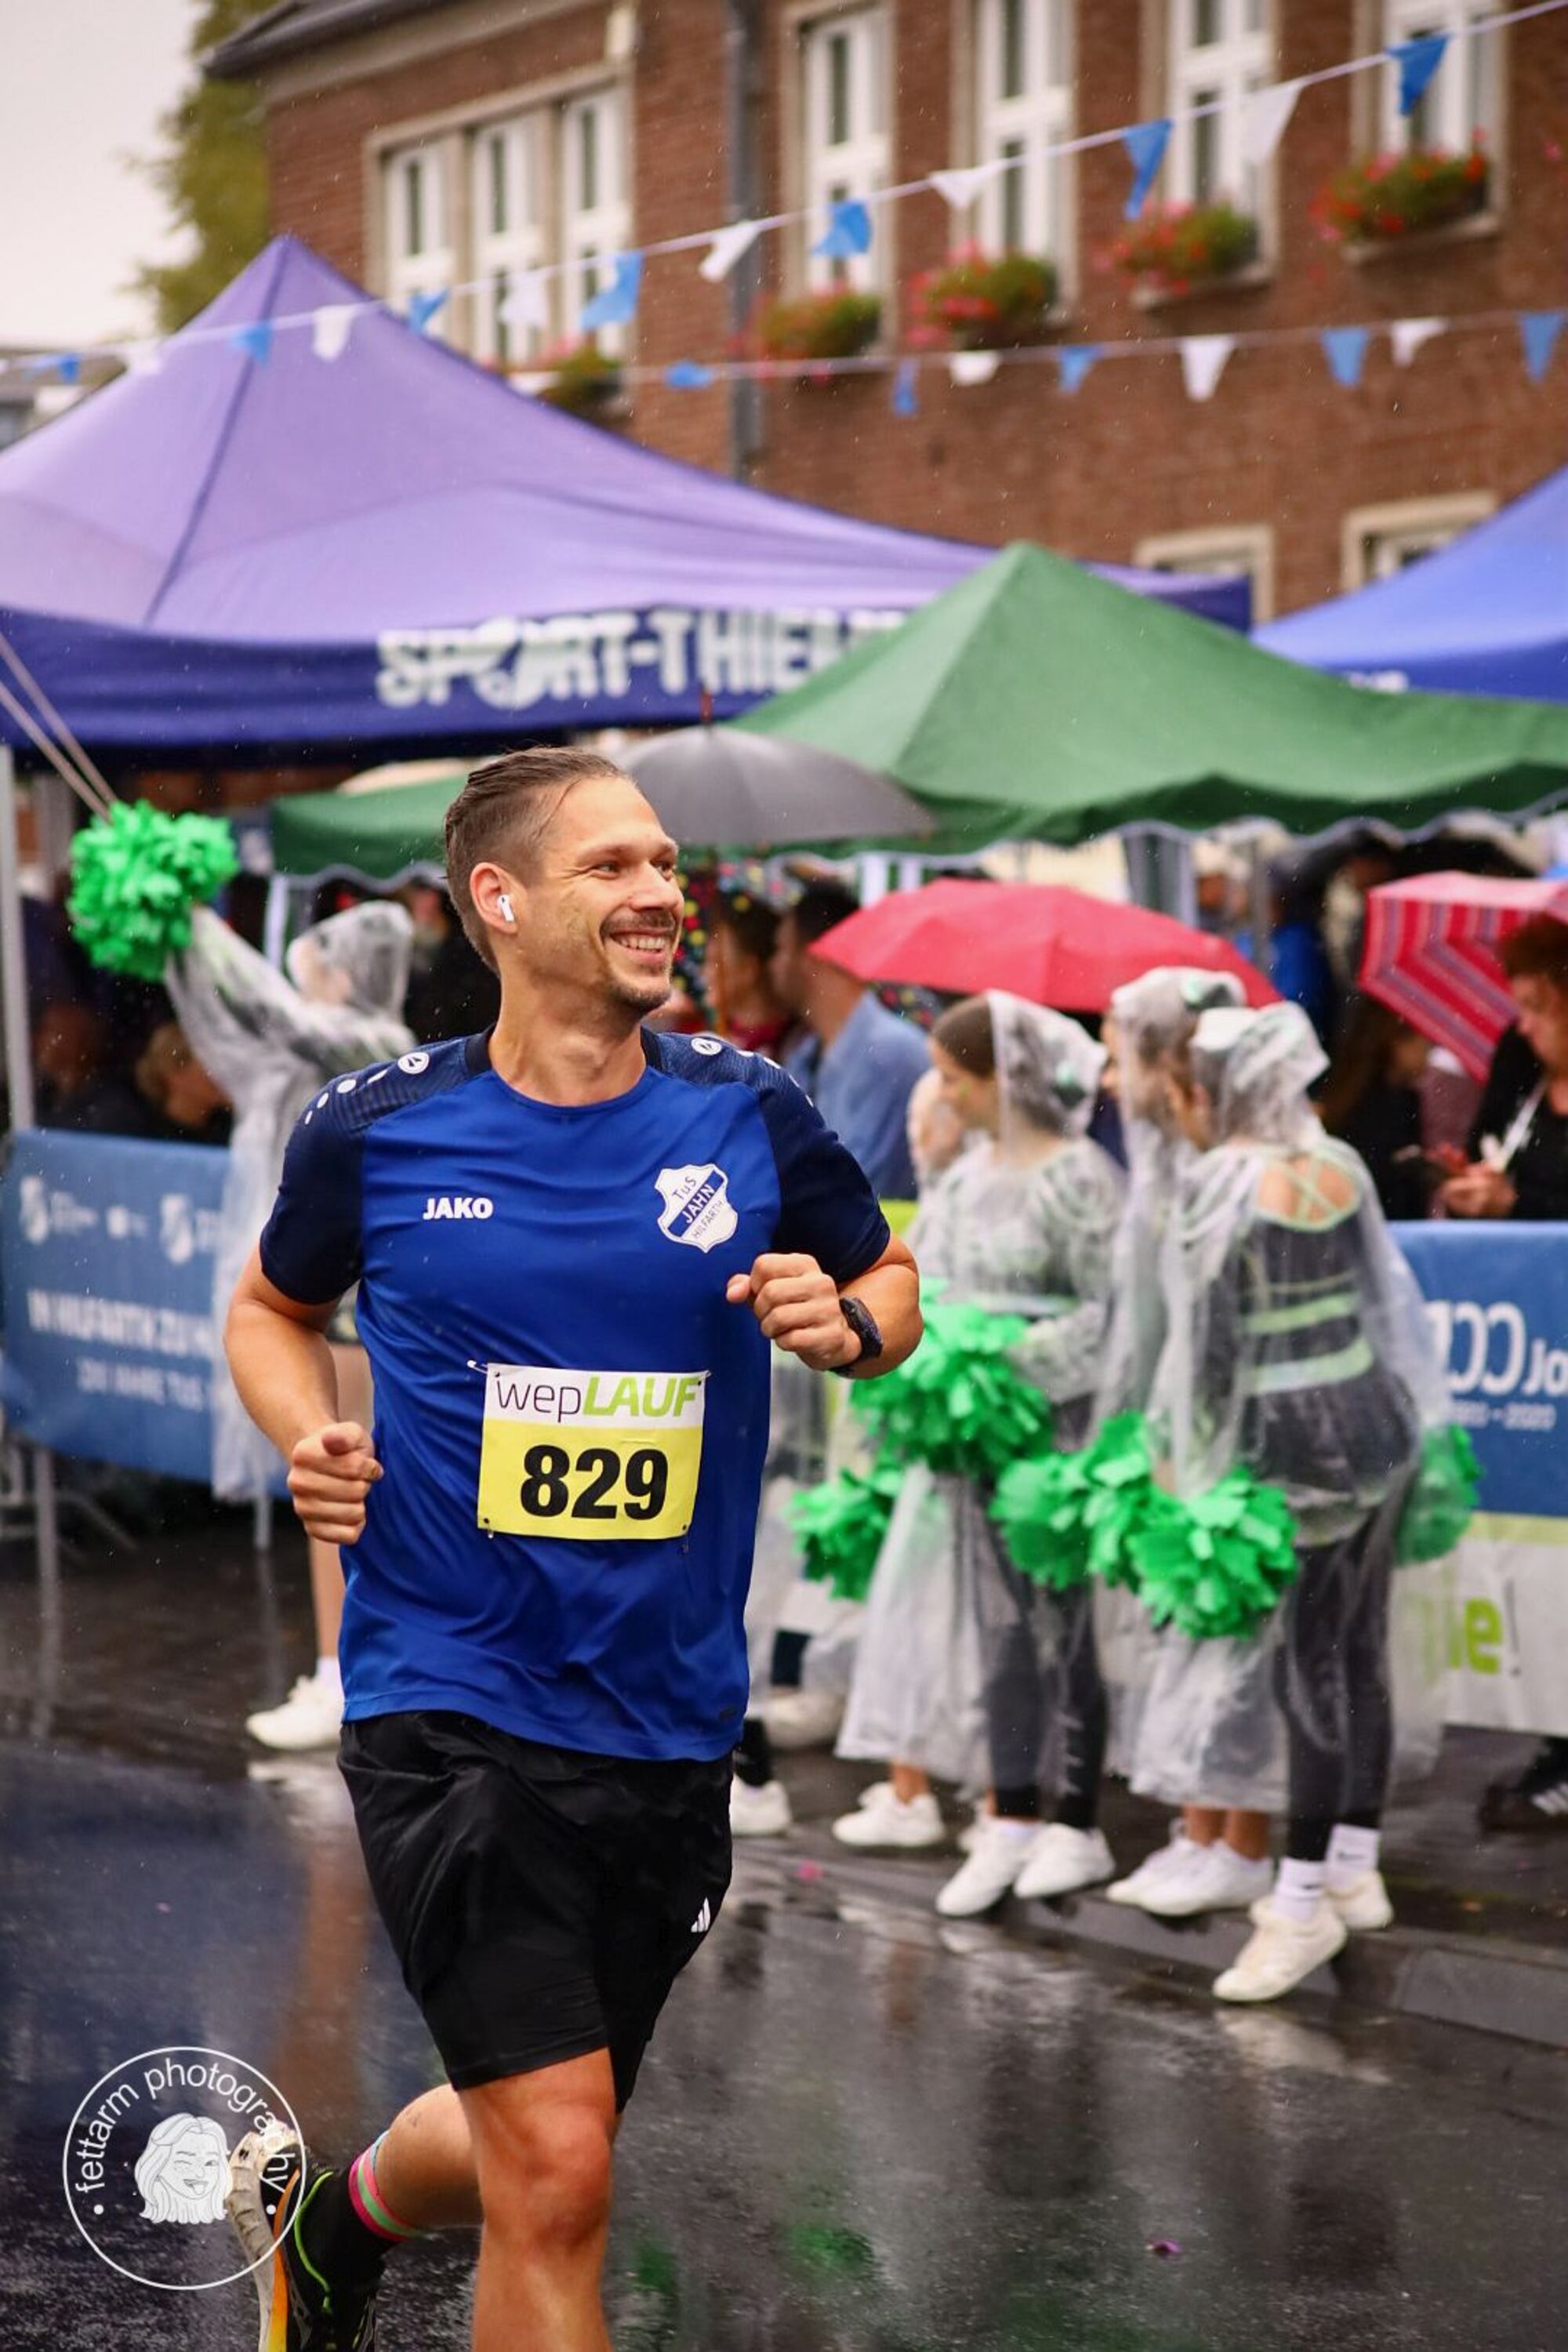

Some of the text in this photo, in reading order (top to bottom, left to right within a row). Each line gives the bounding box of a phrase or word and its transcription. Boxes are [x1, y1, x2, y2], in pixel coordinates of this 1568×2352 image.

[672, 1174, 697, 1200] TuS
[682, 1183, 716, 1224] JAHN
[423, 1197, 494, 1220] JAKO
[691, 1200, 723, 1240] HILFARTH
[495, 1375, 699, 1423] wepLAUF
[520, 1443, 669, 1520] 829
